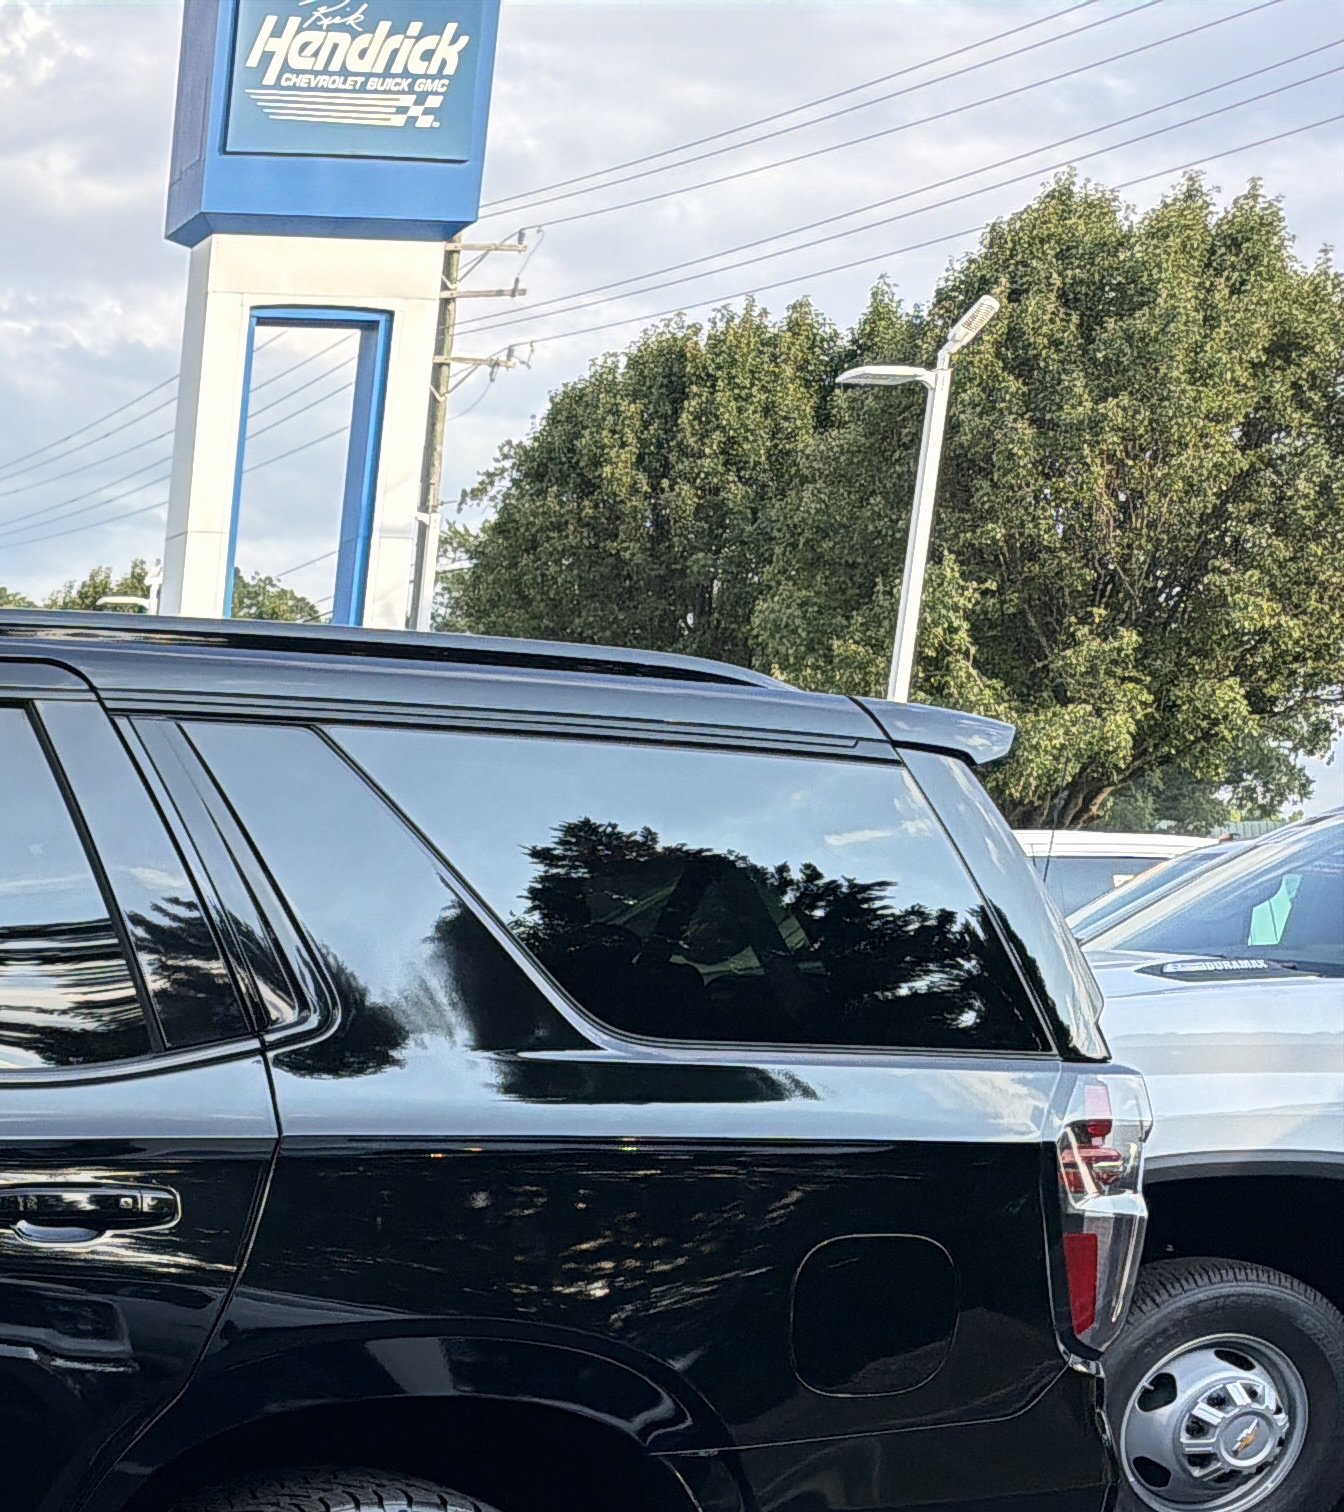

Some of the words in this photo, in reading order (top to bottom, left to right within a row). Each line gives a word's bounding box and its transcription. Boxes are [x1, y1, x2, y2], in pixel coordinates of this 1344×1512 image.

[245, 15, 470, 86] Hendrick
[280, 73, 365, 90] CHEVROLET
[366, 77, 412, 91] BUICK
[413, 79, 450, 93] GMC
[1205, 960, 1269, 971] DURAMAX
